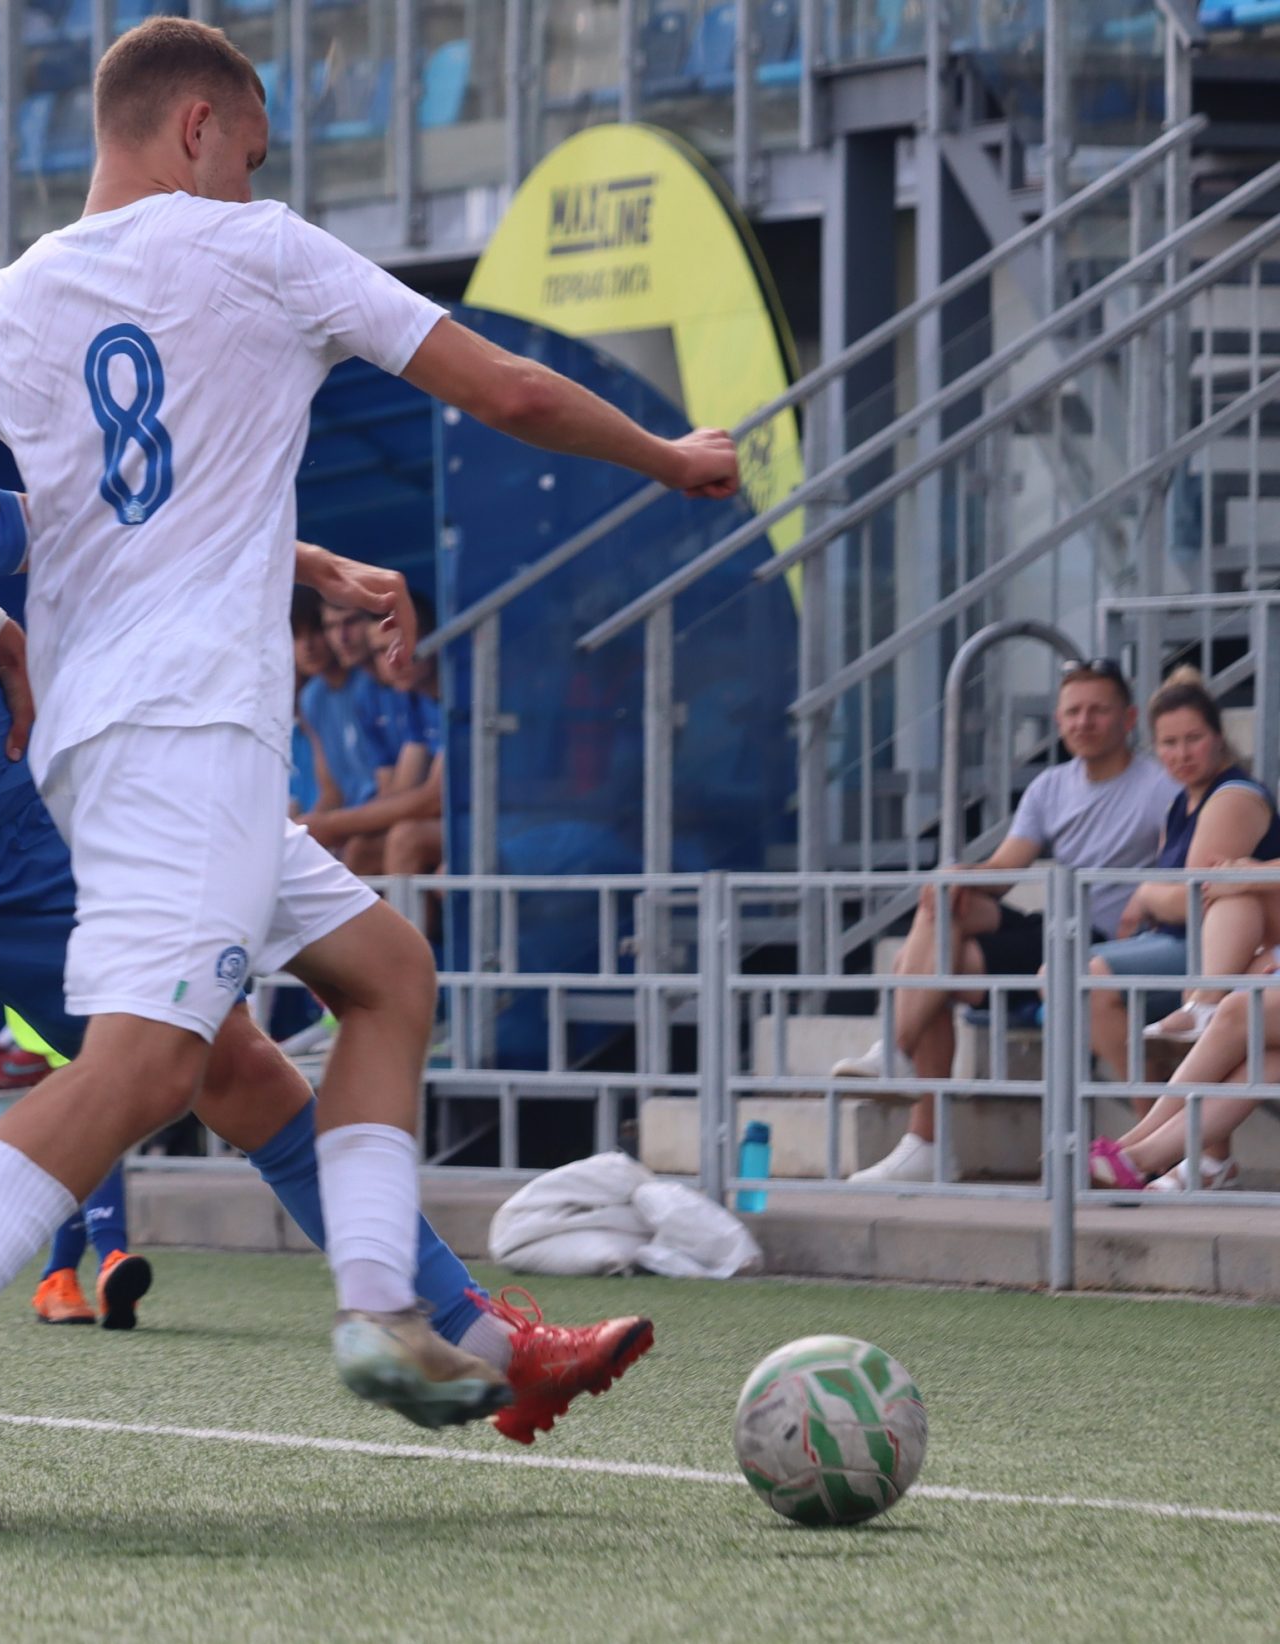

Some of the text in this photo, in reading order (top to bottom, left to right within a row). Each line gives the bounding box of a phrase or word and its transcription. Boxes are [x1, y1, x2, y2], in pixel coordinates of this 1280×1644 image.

[549, 185, 652, 247] MAX LINE
[85, 322, 173, 525] 8
